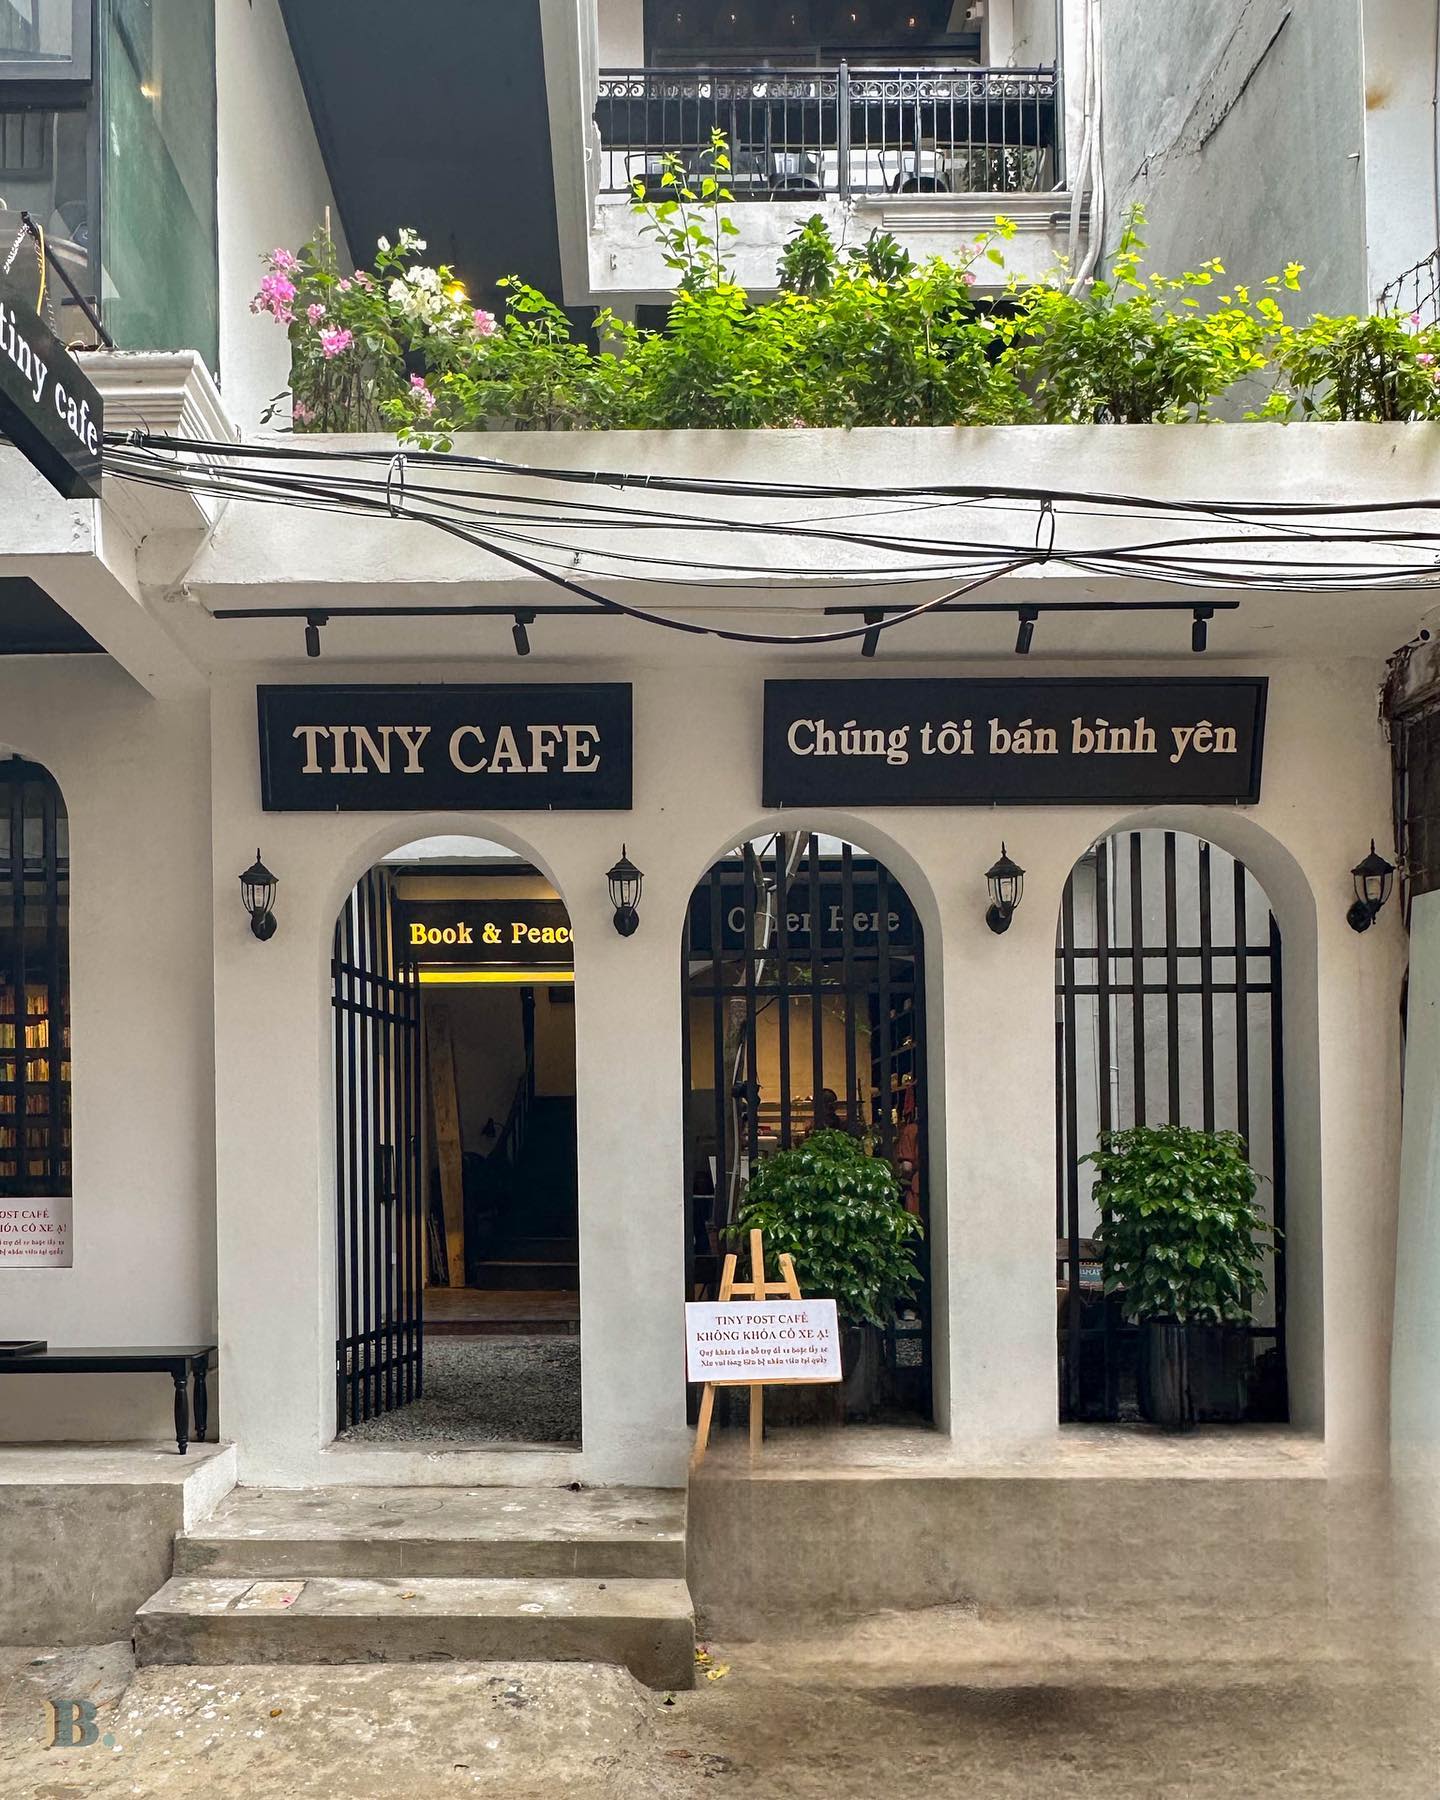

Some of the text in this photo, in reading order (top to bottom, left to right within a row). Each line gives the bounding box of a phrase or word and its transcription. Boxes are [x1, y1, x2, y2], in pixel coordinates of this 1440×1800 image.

[54, 382, 98, 456] cafe
[292, 724, 601, 774] TINY CAFE
[786, 716, 1238, 766] Chúng tôi bán bình yên
[409, 921, 574, 945] Book & Peac
[696, 1329, 740, 1342] KHÔNG
[798, 1329, 815, 1339] XE
[715, 1315, 744, 1326] TINY
[746, 1314, 776, 1325] POST
